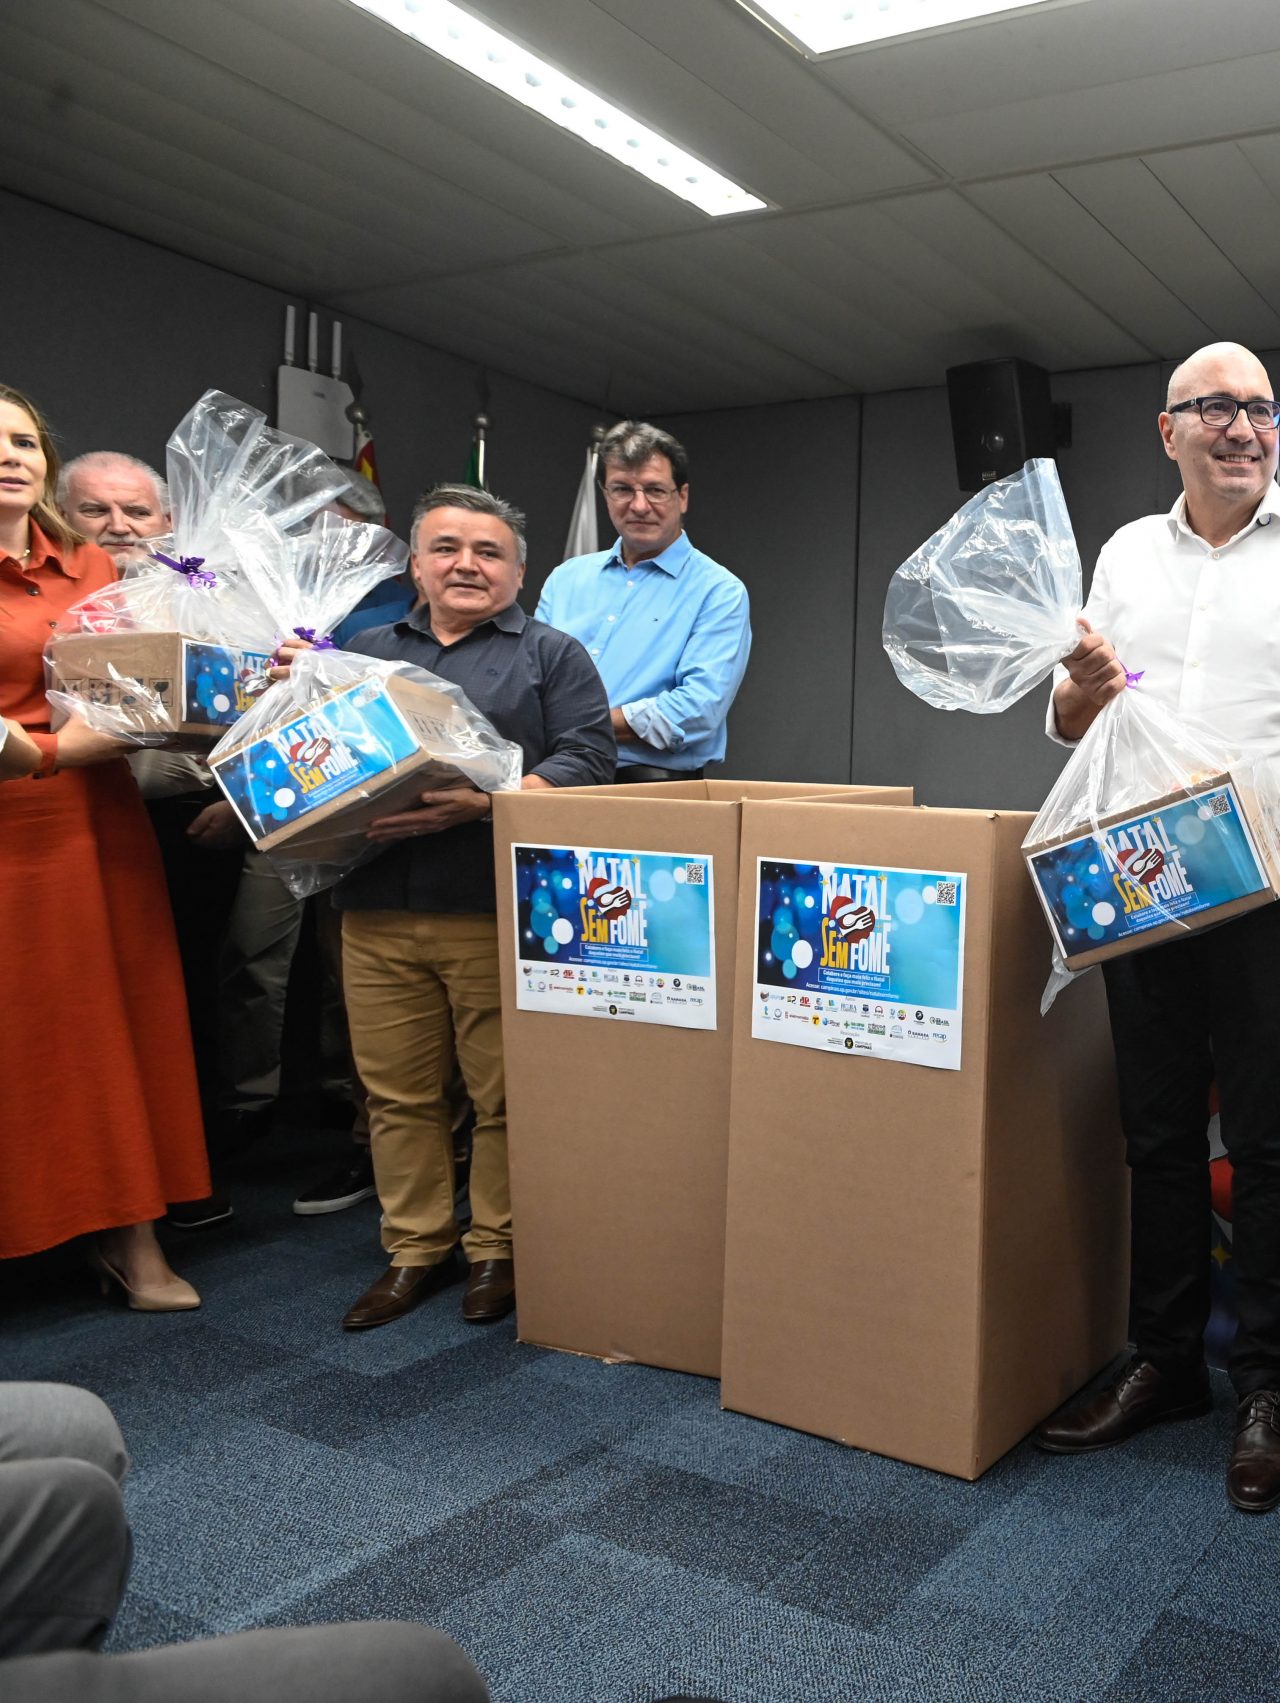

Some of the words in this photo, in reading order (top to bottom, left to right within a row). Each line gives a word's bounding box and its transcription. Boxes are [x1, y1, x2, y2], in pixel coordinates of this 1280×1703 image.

[288, 763, 328, 794] SEM
[1101, 817, 1178, 873] NATAL
[578, 856, 648, 900] NATAL
[821, 872, 892, 921] NATAL
[1113, 873, 1153, 914] SEM
[1148, 850, 1194, 905] FOME
[580, 897, 609, 944] SEM
[610, 901, 649, 947] FOME
[820, 917, 849, 970] SEM
[850, 922, 891, 975] FOME
